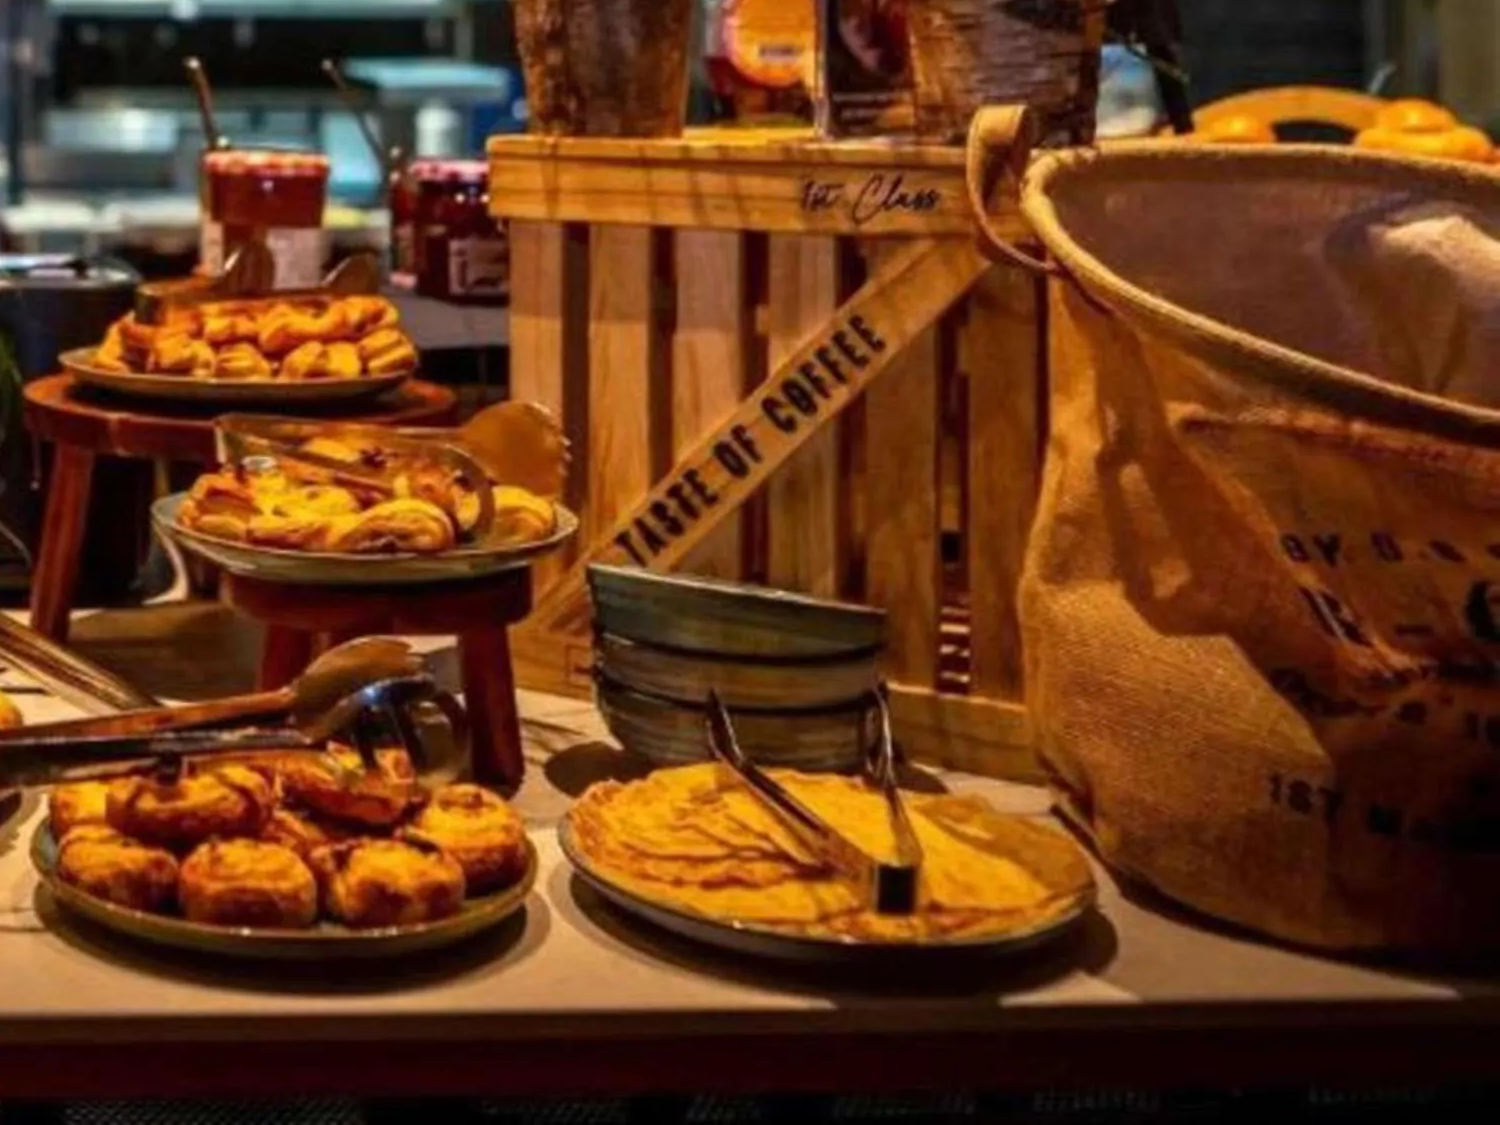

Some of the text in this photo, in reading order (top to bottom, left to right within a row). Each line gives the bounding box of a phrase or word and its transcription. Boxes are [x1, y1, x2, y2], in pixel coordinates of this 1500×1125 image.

[852, 173, 940, 225] Class
[614, 315, 886, 567] TASTE OF COFFEE
